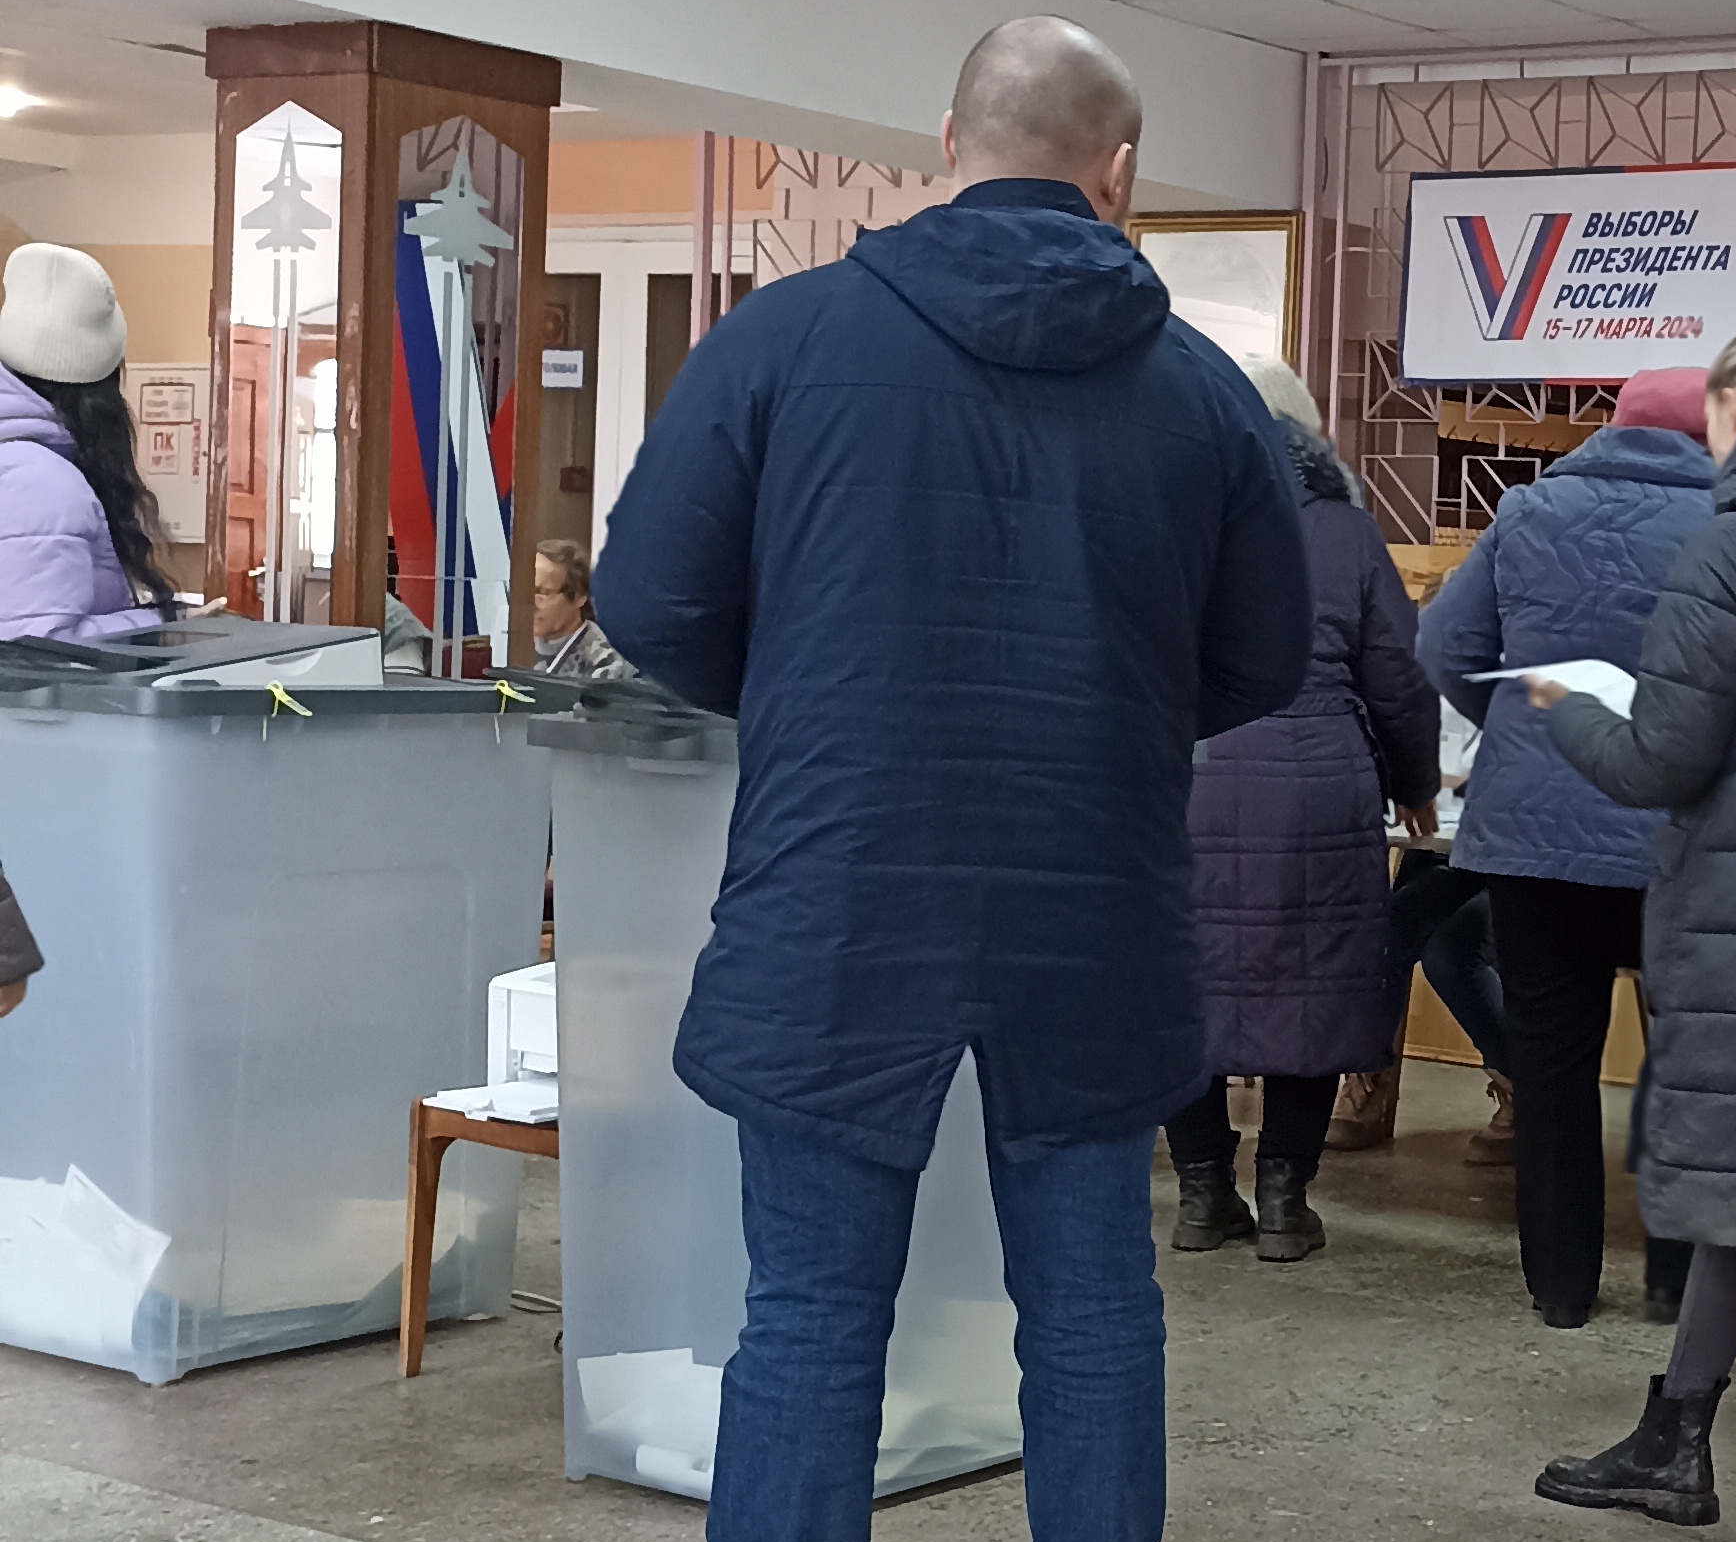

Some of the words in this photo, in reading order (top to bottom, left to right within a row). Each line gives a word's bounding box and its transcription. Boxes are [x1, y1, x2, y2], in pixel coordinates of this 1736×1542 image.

[1582, 210, 1699, 238] ВЫБОРЫ
[1567, 245, 1731, 276] ПРЕЗИДЕНТА
[1553, 283, 1658, 309] РОССИИ
[1594, 316, 1655, 339] МАРТА
[1655, 316, 1704, 339] 2024
